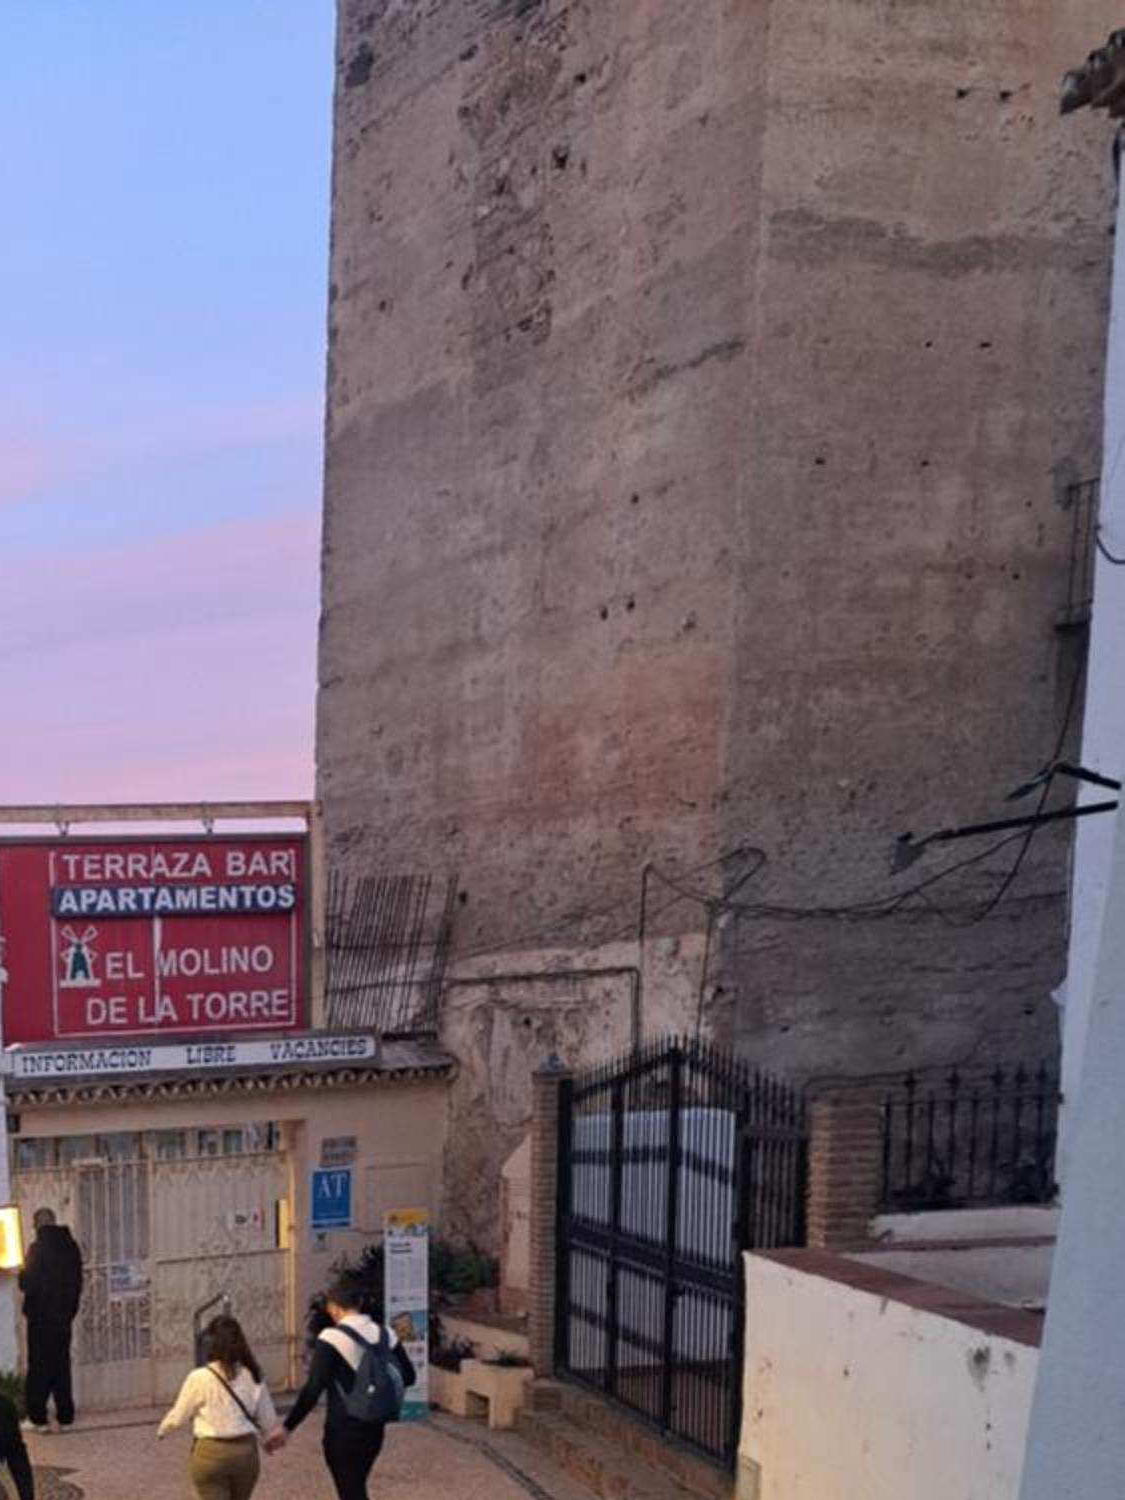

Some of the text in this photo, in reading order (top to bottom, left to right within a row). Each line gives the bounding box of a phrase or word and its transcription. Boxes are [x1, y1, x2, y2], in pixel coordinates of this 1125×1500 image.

[62, 850, 291, 881] TERRAZA BAR
[58, 884, 296, 913] APARTAMENTOS
[105, 945, 274, 980] EL MOLINO
[86, 989, 289, 1025] DE LA TORRE
[22, 1038, 368, 1073] INFORMACION LIBRE VACANCIES
